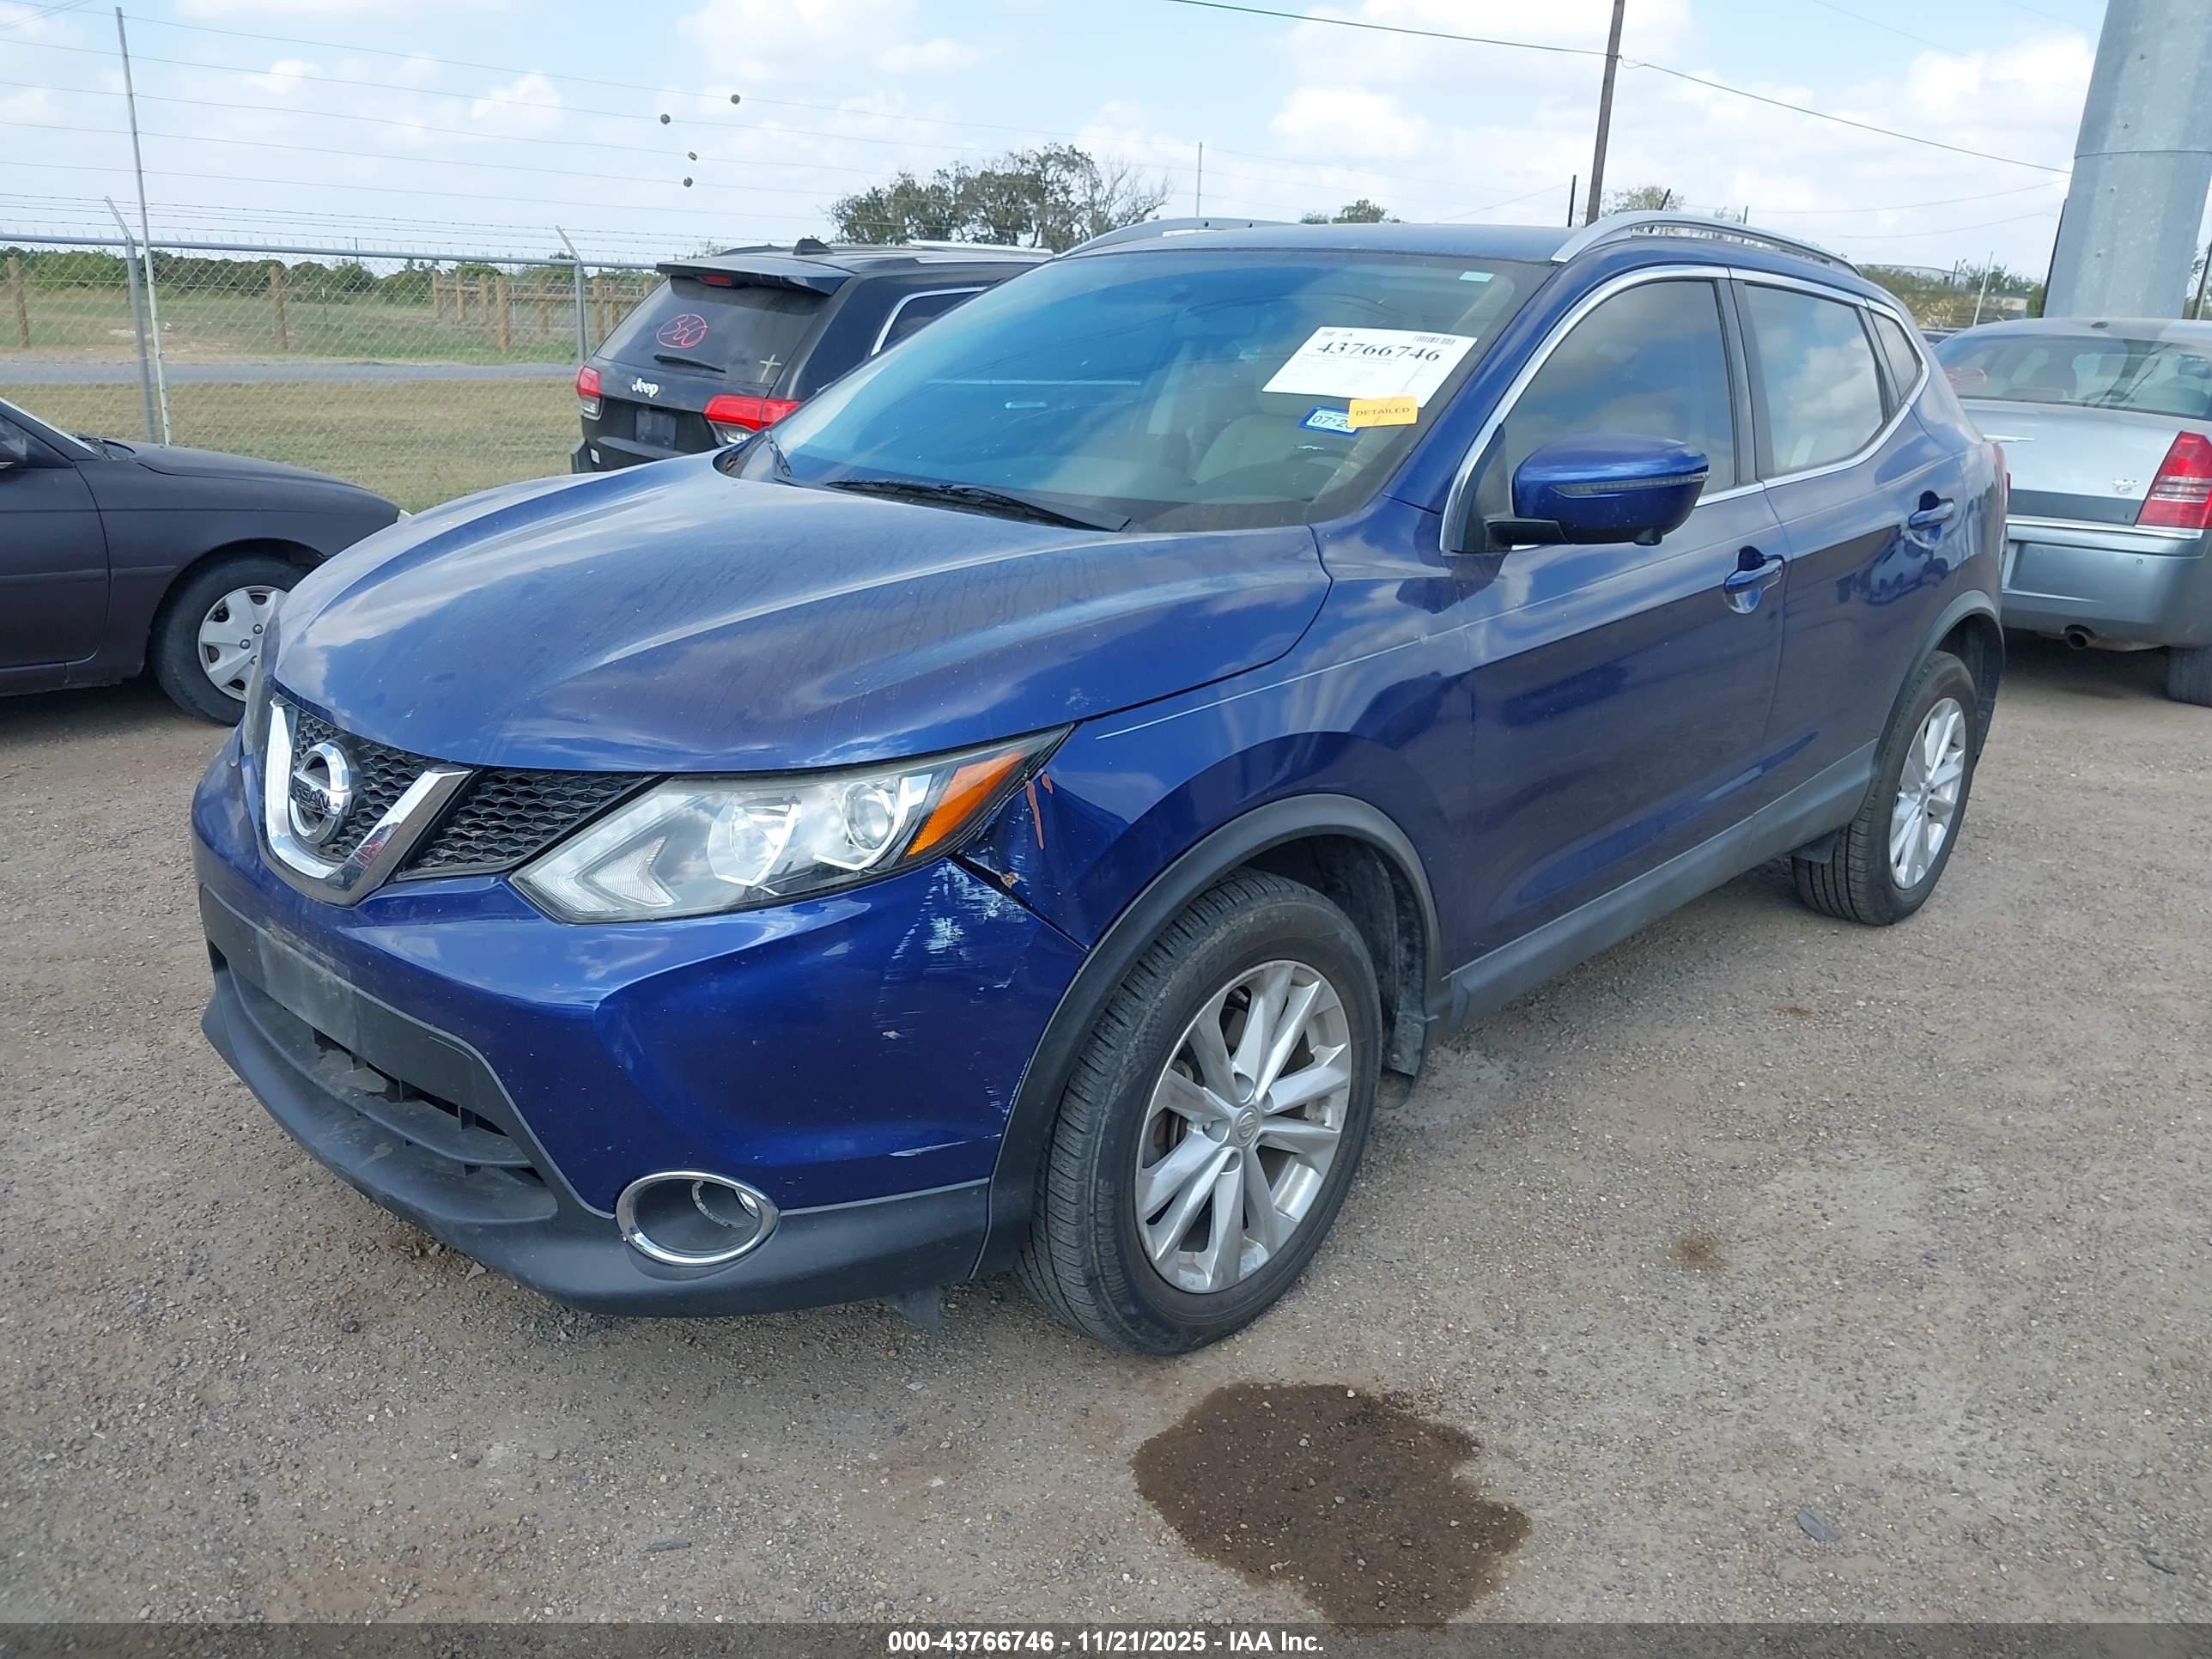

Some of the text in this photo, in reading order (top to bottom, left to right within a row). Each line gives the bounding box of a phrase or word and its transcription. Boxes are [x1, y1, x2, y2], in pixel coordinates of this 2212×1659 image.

[1316, 341, 1445, 362] 43766746
[631, 377, 659, 398] Jeep
[1355, 407, 1411, 416] DETAILED
